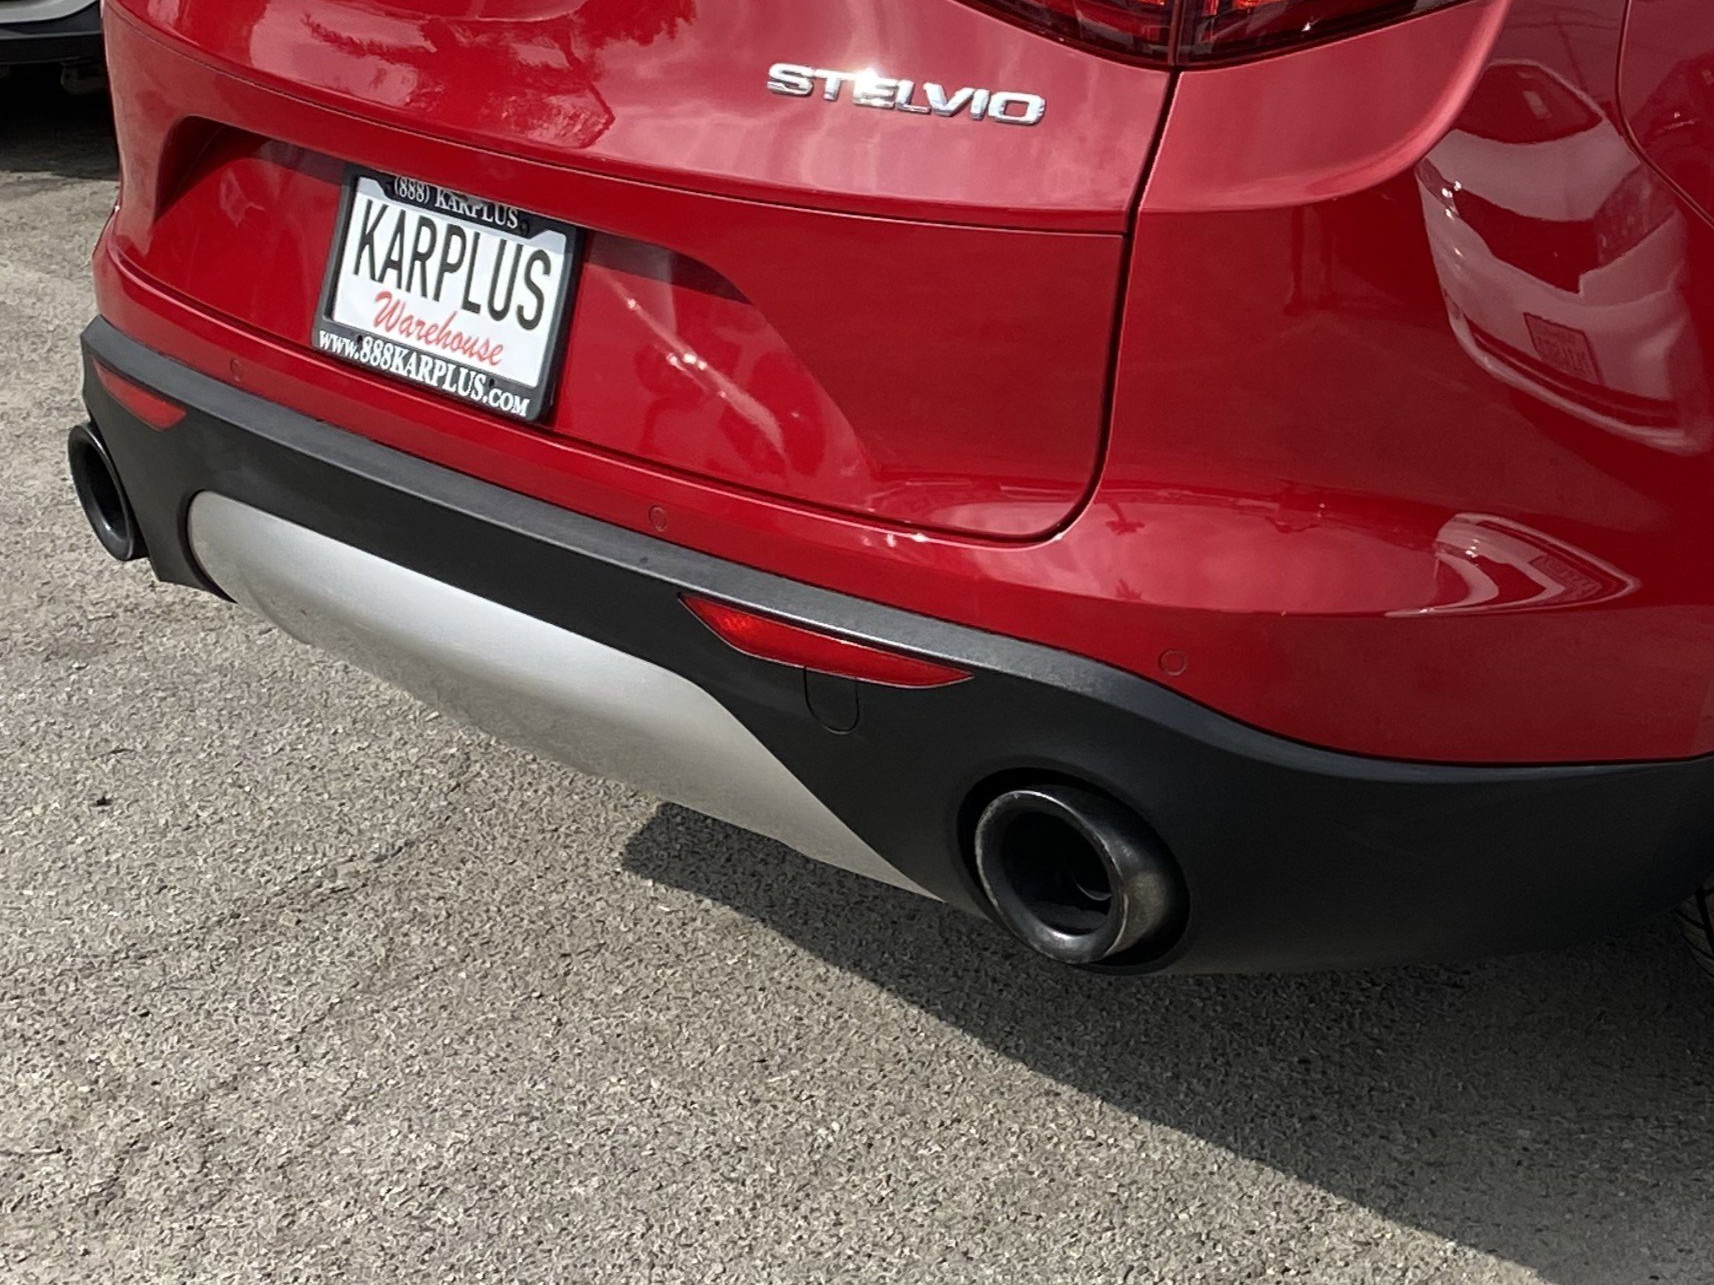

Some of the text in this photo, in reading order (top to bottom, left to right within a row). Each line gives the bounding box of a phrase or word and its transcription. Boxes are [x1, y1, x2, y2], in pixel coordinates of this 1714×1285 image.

[767, 63, 1046, 125] STELVIO
[394, 176, 519, 229] (888) KARPLUS
[353, 199, 551, 331] KARPLUS
[373, 291, 505, 366] Warehouse
